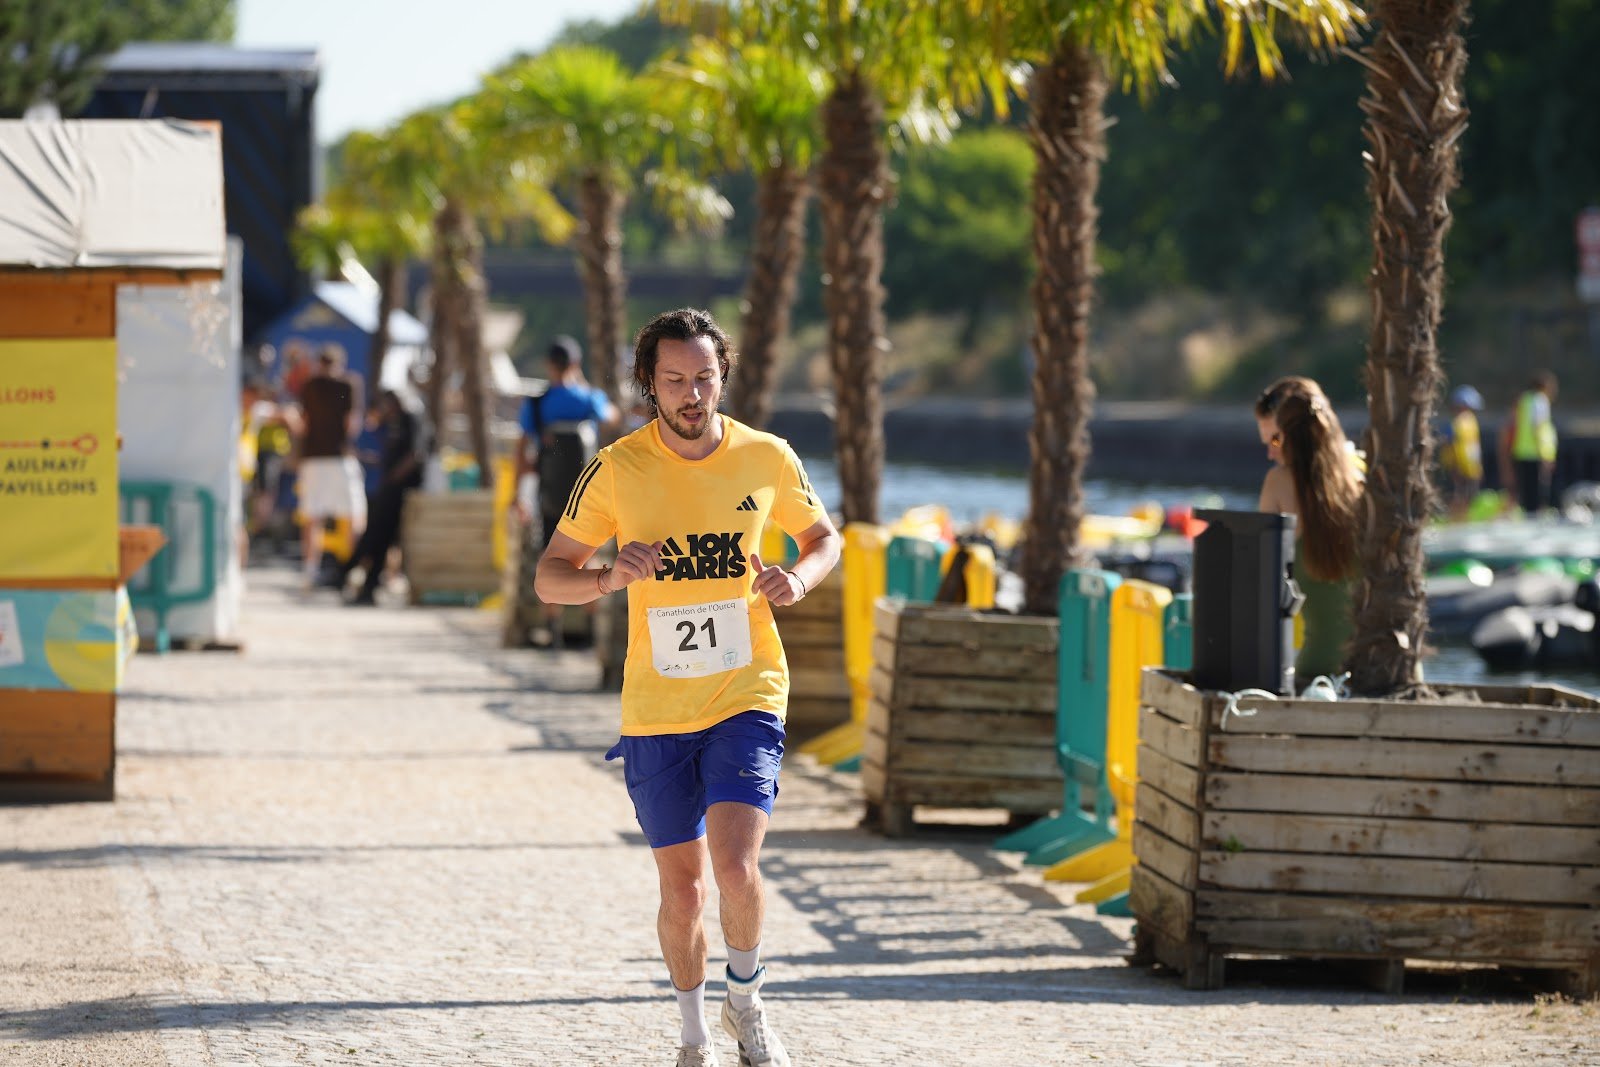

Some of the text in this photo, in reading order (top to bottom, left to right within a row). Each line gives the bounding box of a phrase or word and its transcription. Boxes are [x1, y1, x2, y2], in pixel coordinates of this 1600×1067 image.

[686, 532, 744, 557] 10K
[655, 556, 746, 581] PARIS
[656, 608, 695, 617] Canathlon
[708, 602, 736, 611] l'Ourcq
[676, 617, 717, 651] 21
